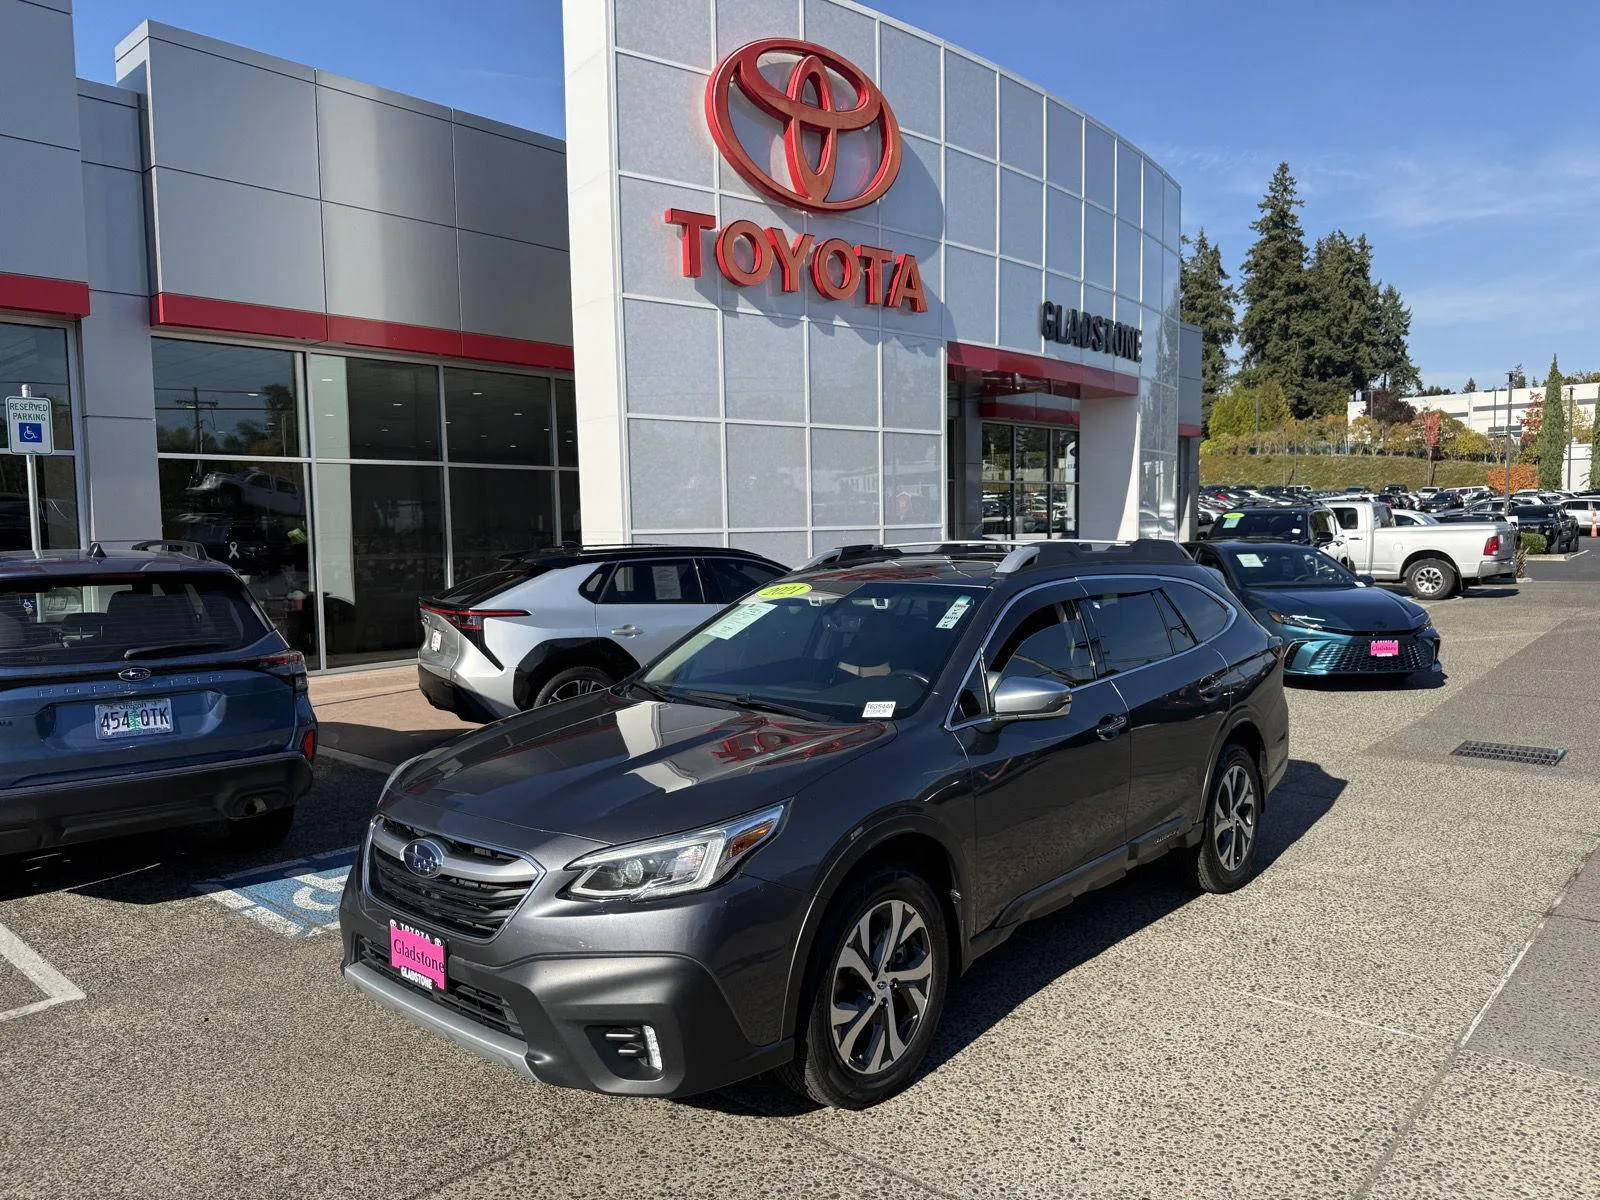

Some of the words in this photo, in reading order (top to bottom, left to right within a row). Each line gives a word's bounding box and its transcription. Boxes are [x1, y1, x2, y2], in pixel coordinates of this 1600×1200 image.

[665, 208, 928, 313] TOYOTA
[1041, 301, 1142, 363] GLADSTONE
[10, 403, 48, 412] RESERVED
[12, 412, 46, 422] PARKING
[100, 712, 131, 731] 454
[400, 922, 431, 941] TOYOTA
[394, 938, 445, 974] Gladstone
[400, 966, 433, 990] GLADSTONE
